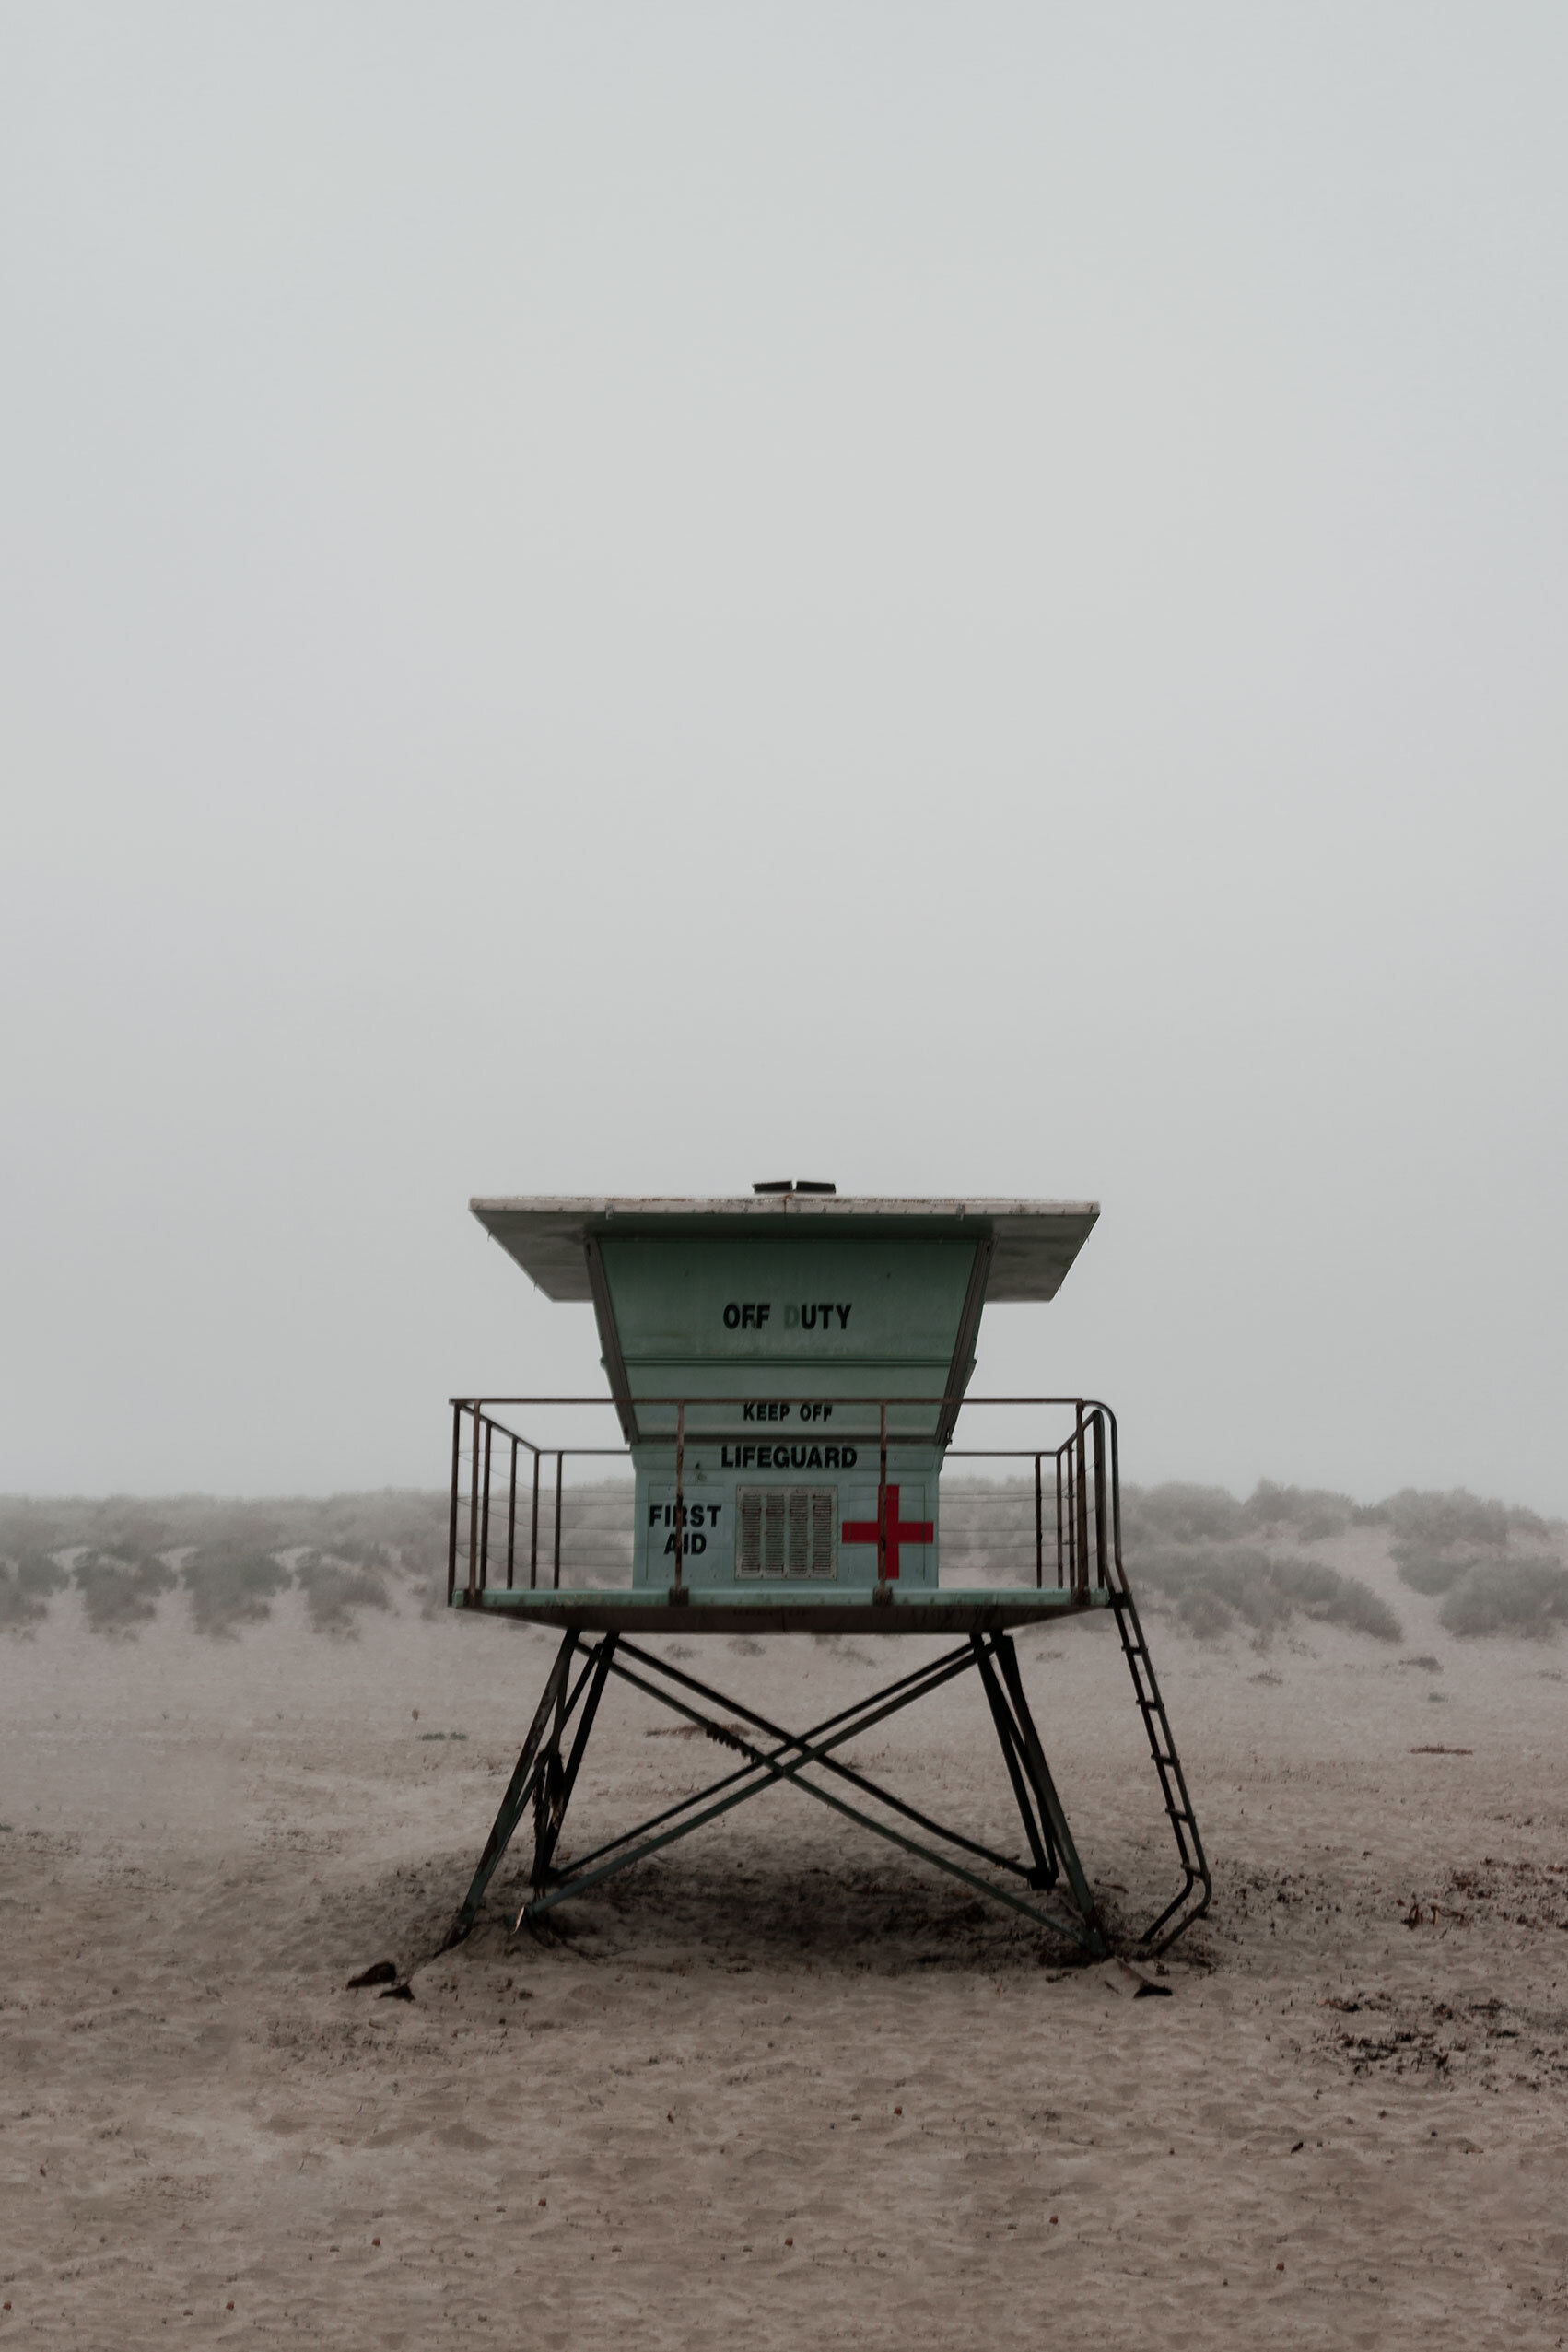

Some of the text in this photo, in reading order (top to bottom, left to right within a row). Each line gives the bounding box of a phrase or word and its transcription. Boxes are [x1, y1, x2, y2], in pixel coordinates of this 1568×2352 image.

[723, 1305, 852, 1329] OFF DUTY
[743, 1403, 833, 1422] KEEP OFF
[721, 1446, 858, 1469] LIFEGUARD
